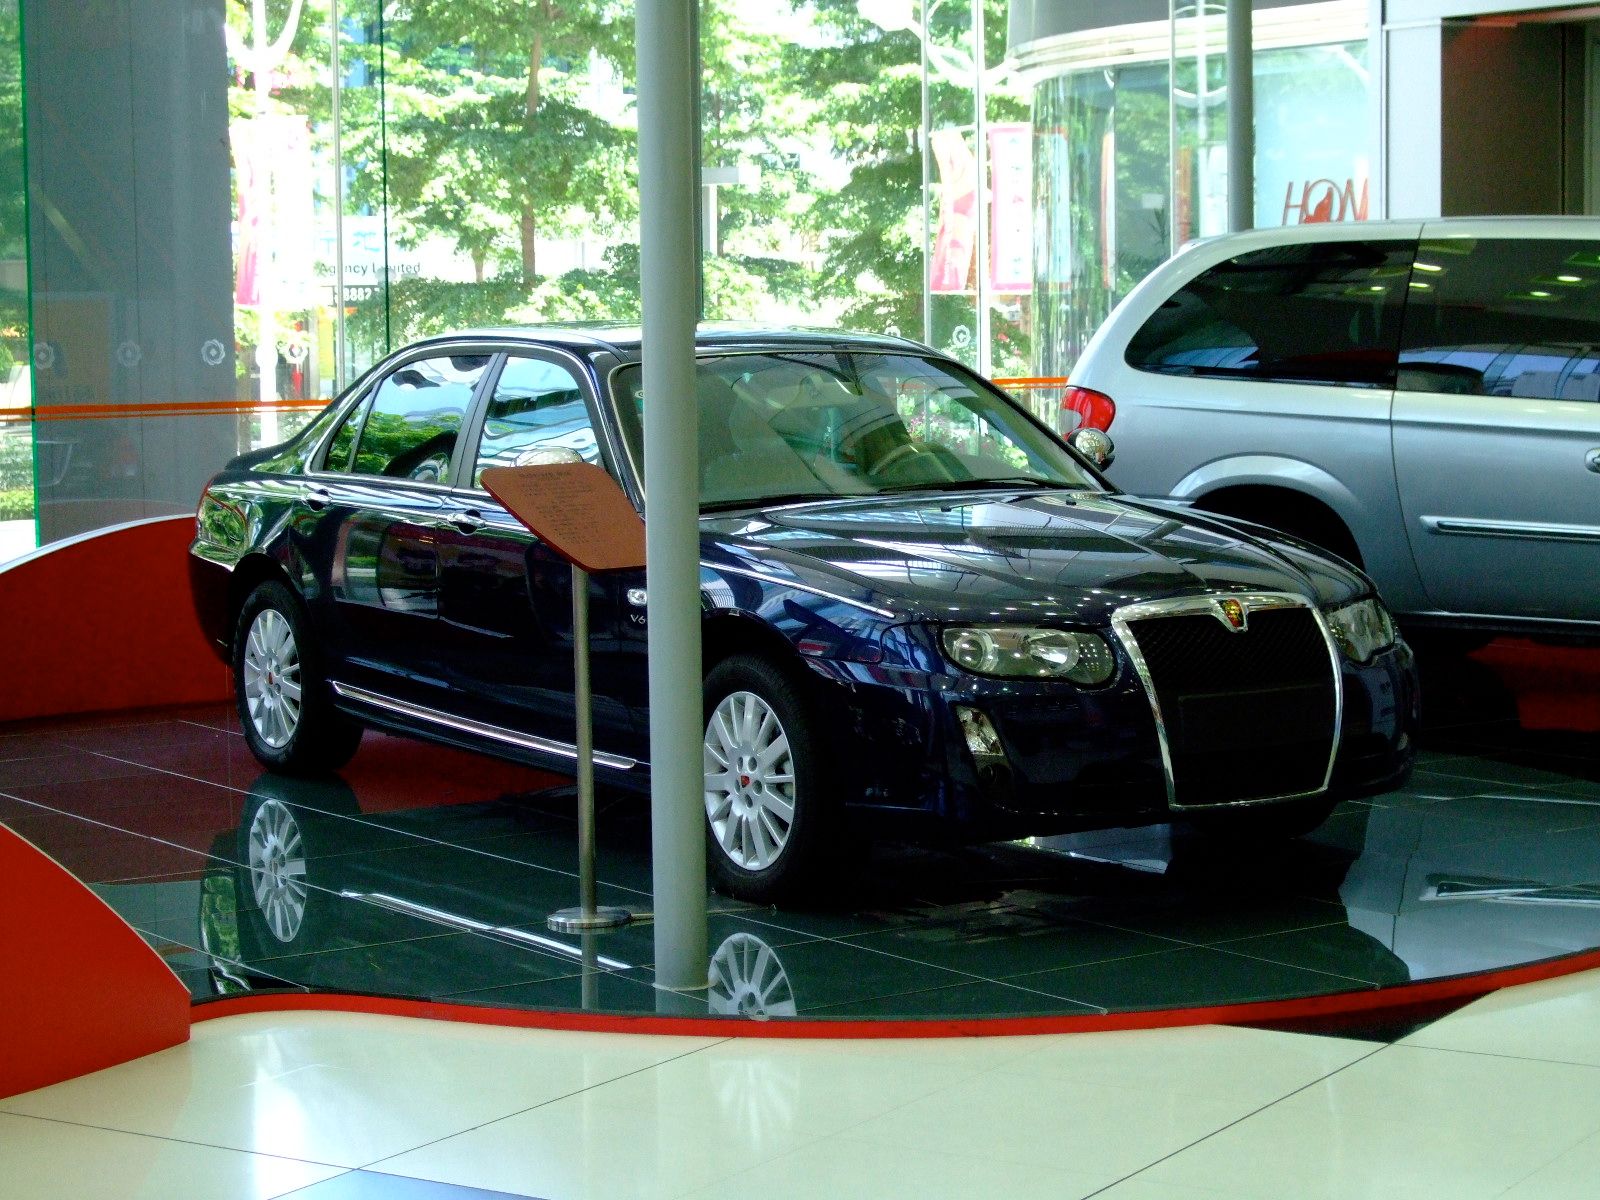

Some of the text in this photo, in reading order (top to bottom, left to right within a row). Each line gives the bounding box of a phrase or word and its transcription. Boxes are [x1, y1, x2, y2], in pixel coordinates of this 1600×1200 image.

[320, 262, 420, 276] Agncy Lmited
[630, 614, 646, 624] V6
